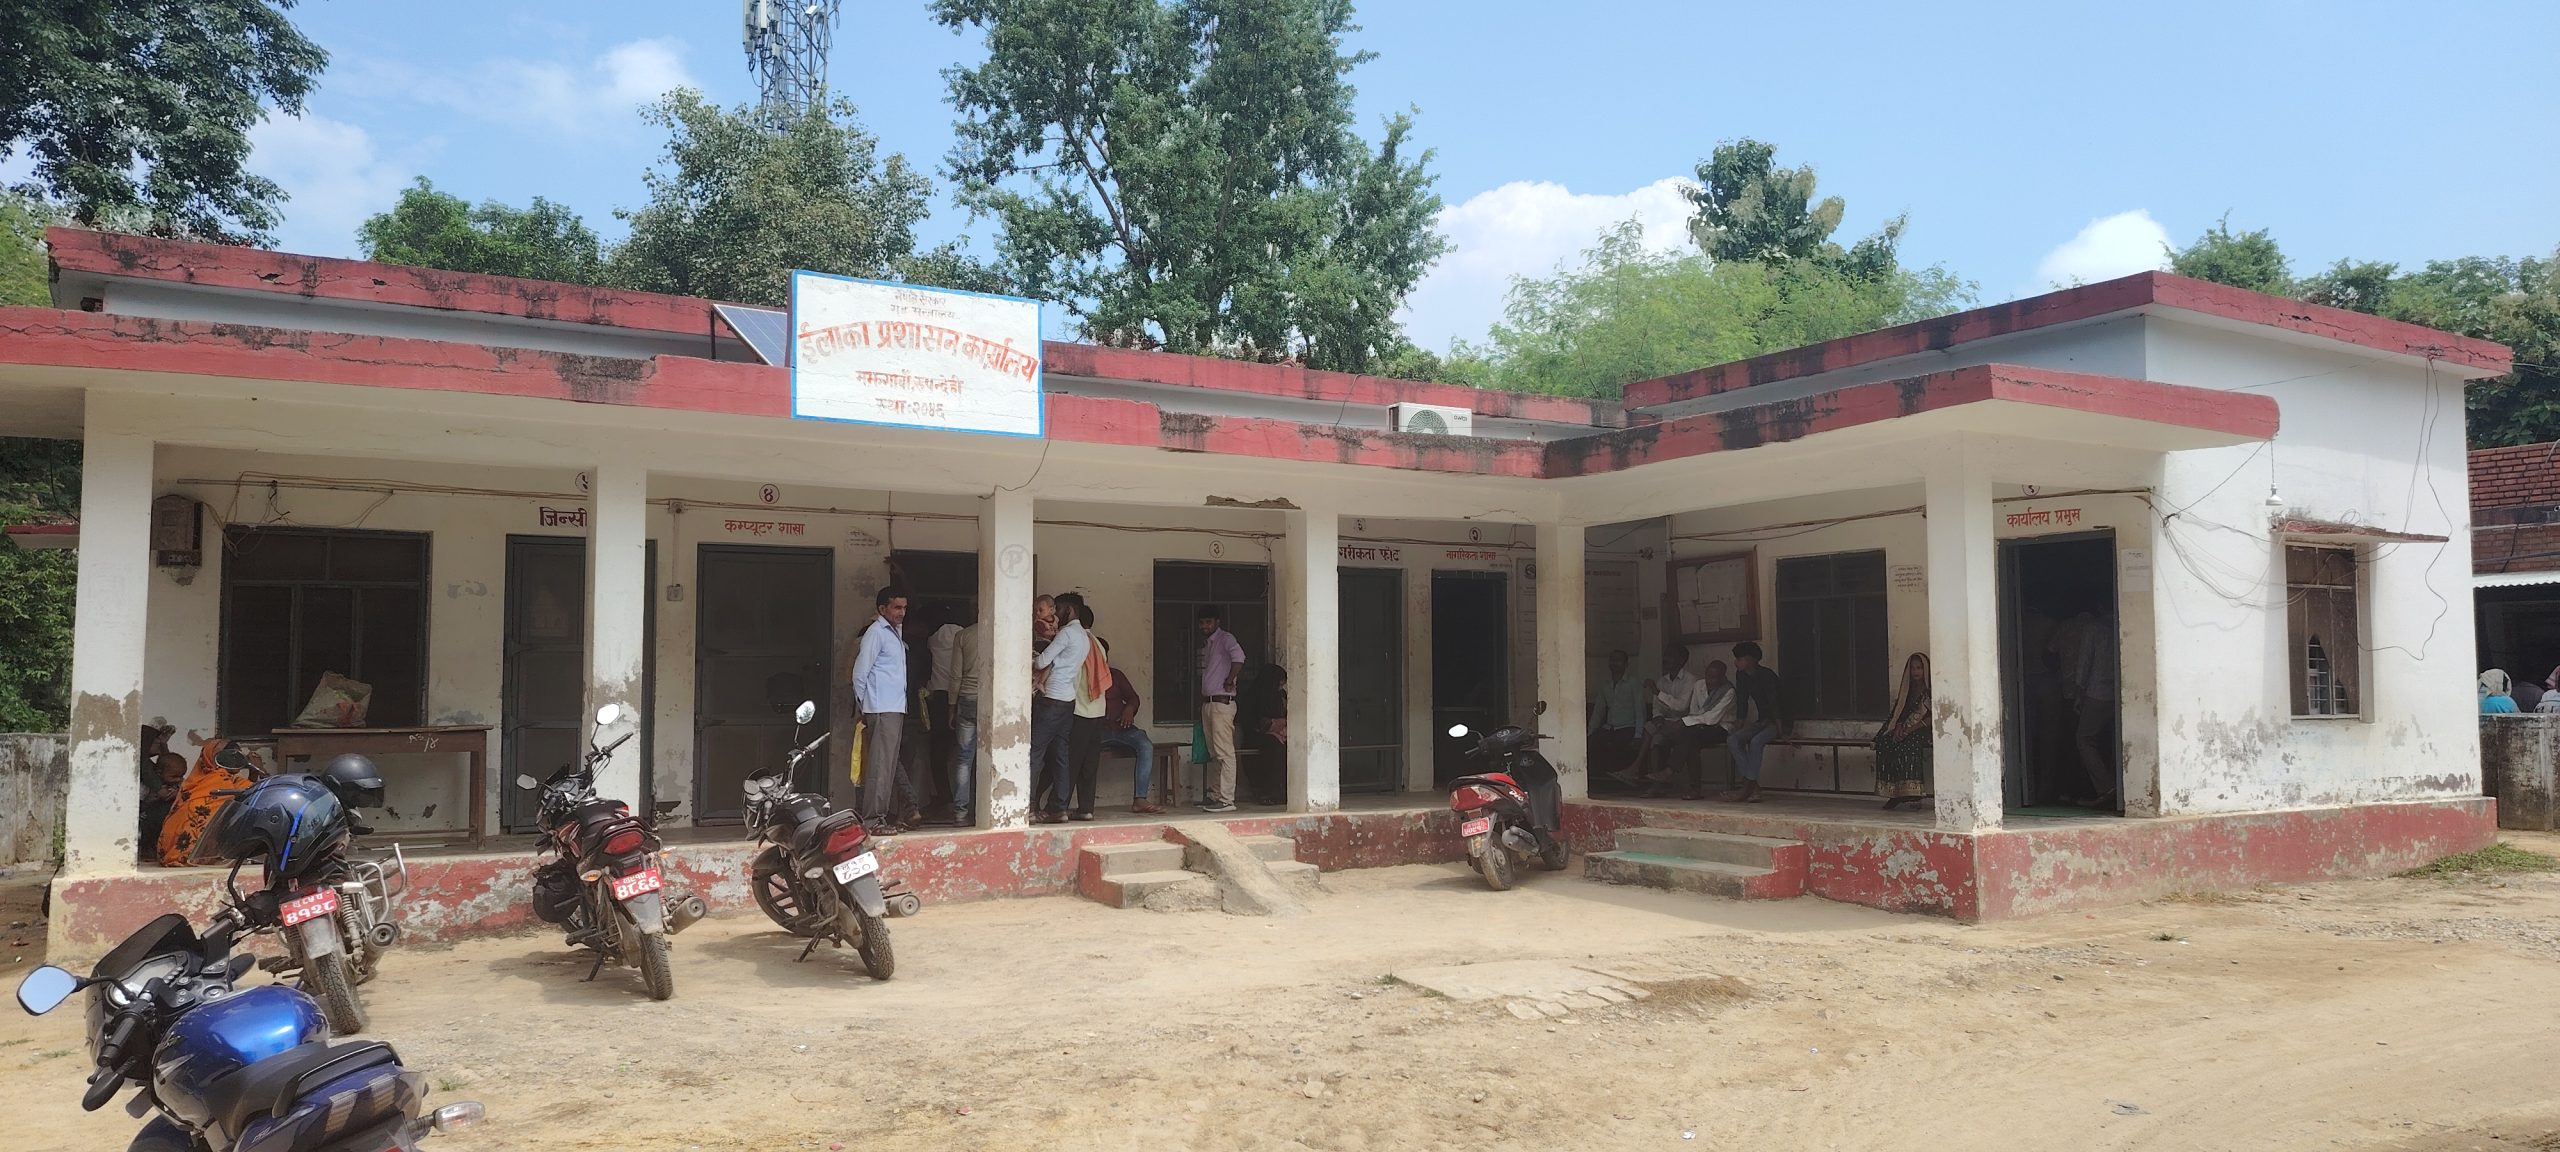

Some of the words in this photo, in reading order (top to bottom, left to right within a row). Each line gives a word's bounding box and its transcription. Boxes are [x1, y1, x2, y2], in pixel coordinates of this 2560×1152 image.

[875, 320, 961, 355] प्रशासन
[962, 334, 1039, 383] कार्यालय
[724, 519, 774, 536] कम्प्यूटर
[777, 522, 806, 536] शाखा
[2006, 506, 2051, 527] कार्यालय
[2054, 508, 2081, 526] प्रमुख
[286, 900, 335, 923] ४१२८
